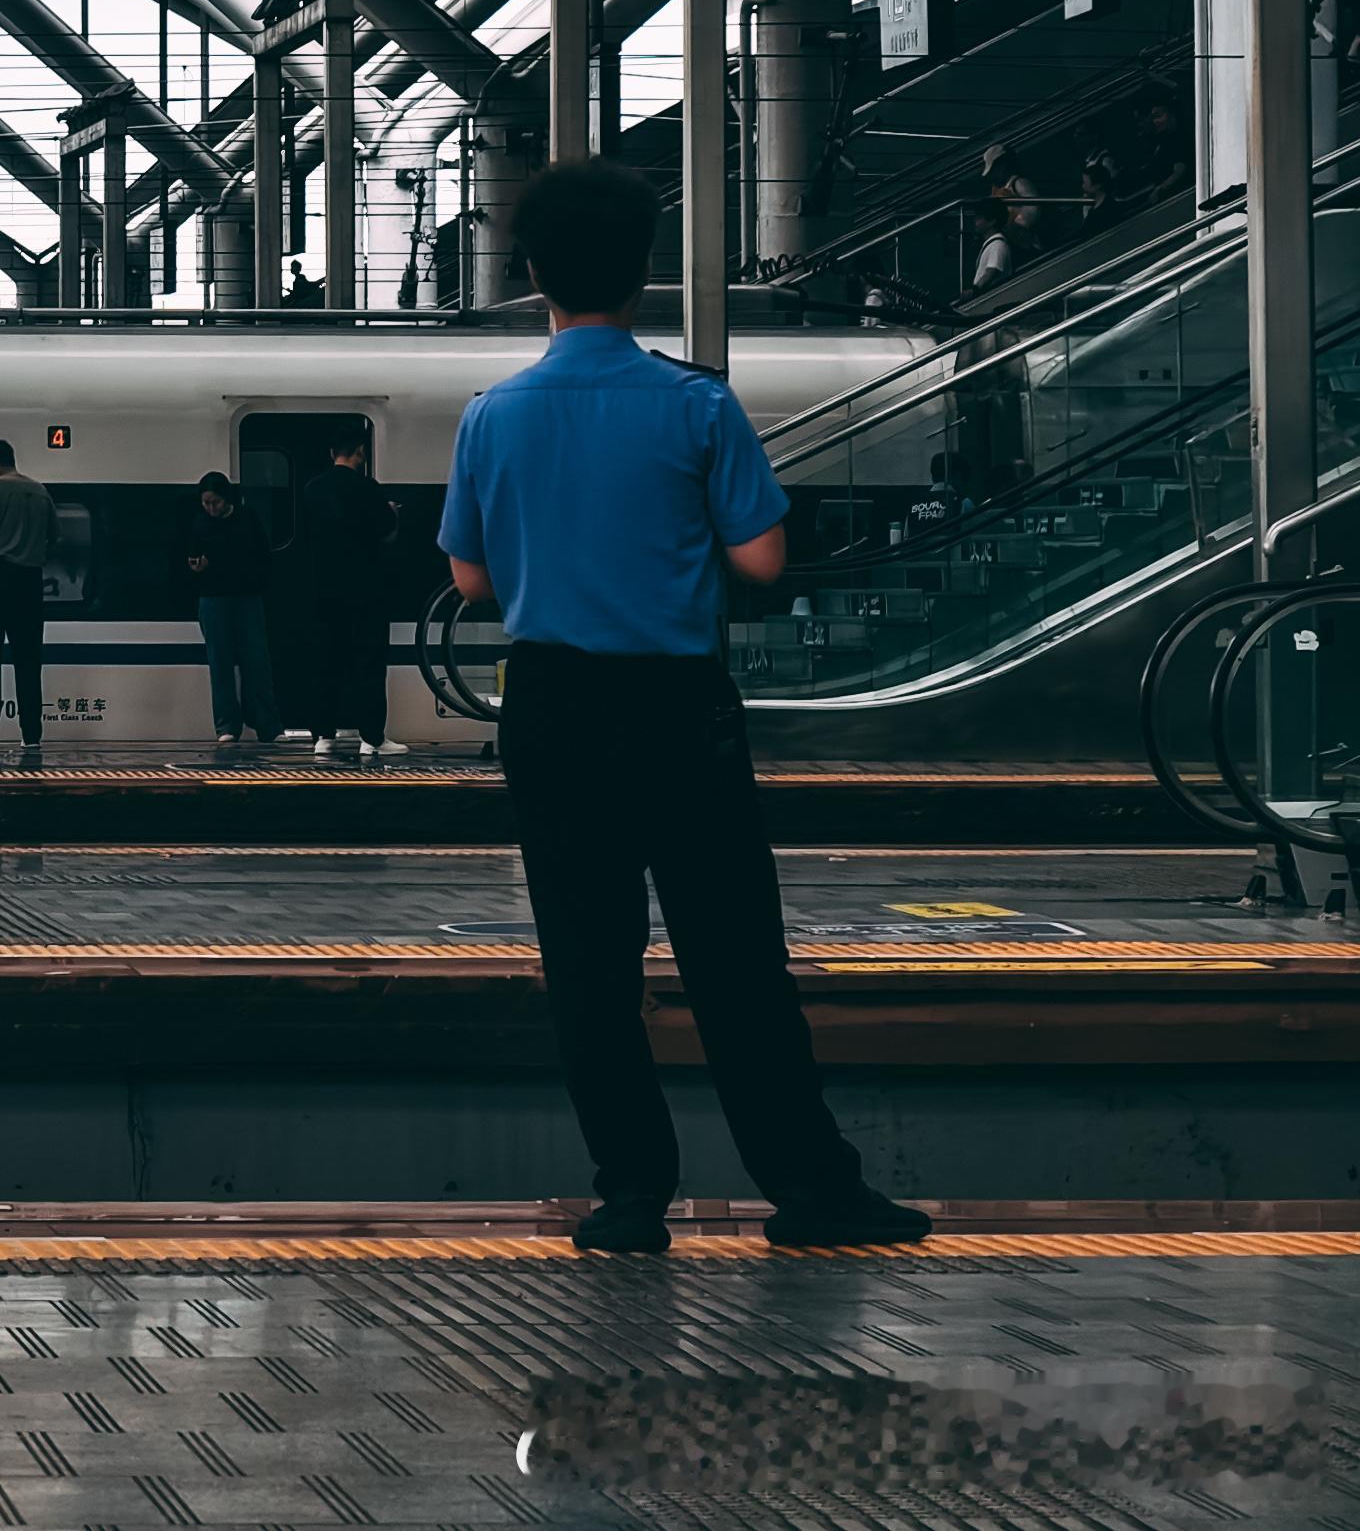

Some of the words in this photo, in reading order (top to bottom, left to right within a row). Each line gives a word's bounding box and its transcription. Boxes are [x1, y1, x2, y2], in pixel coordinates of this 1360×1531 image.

[51, 428, 65, 447] 4
[41, 698, 107, 712] 一等座车
